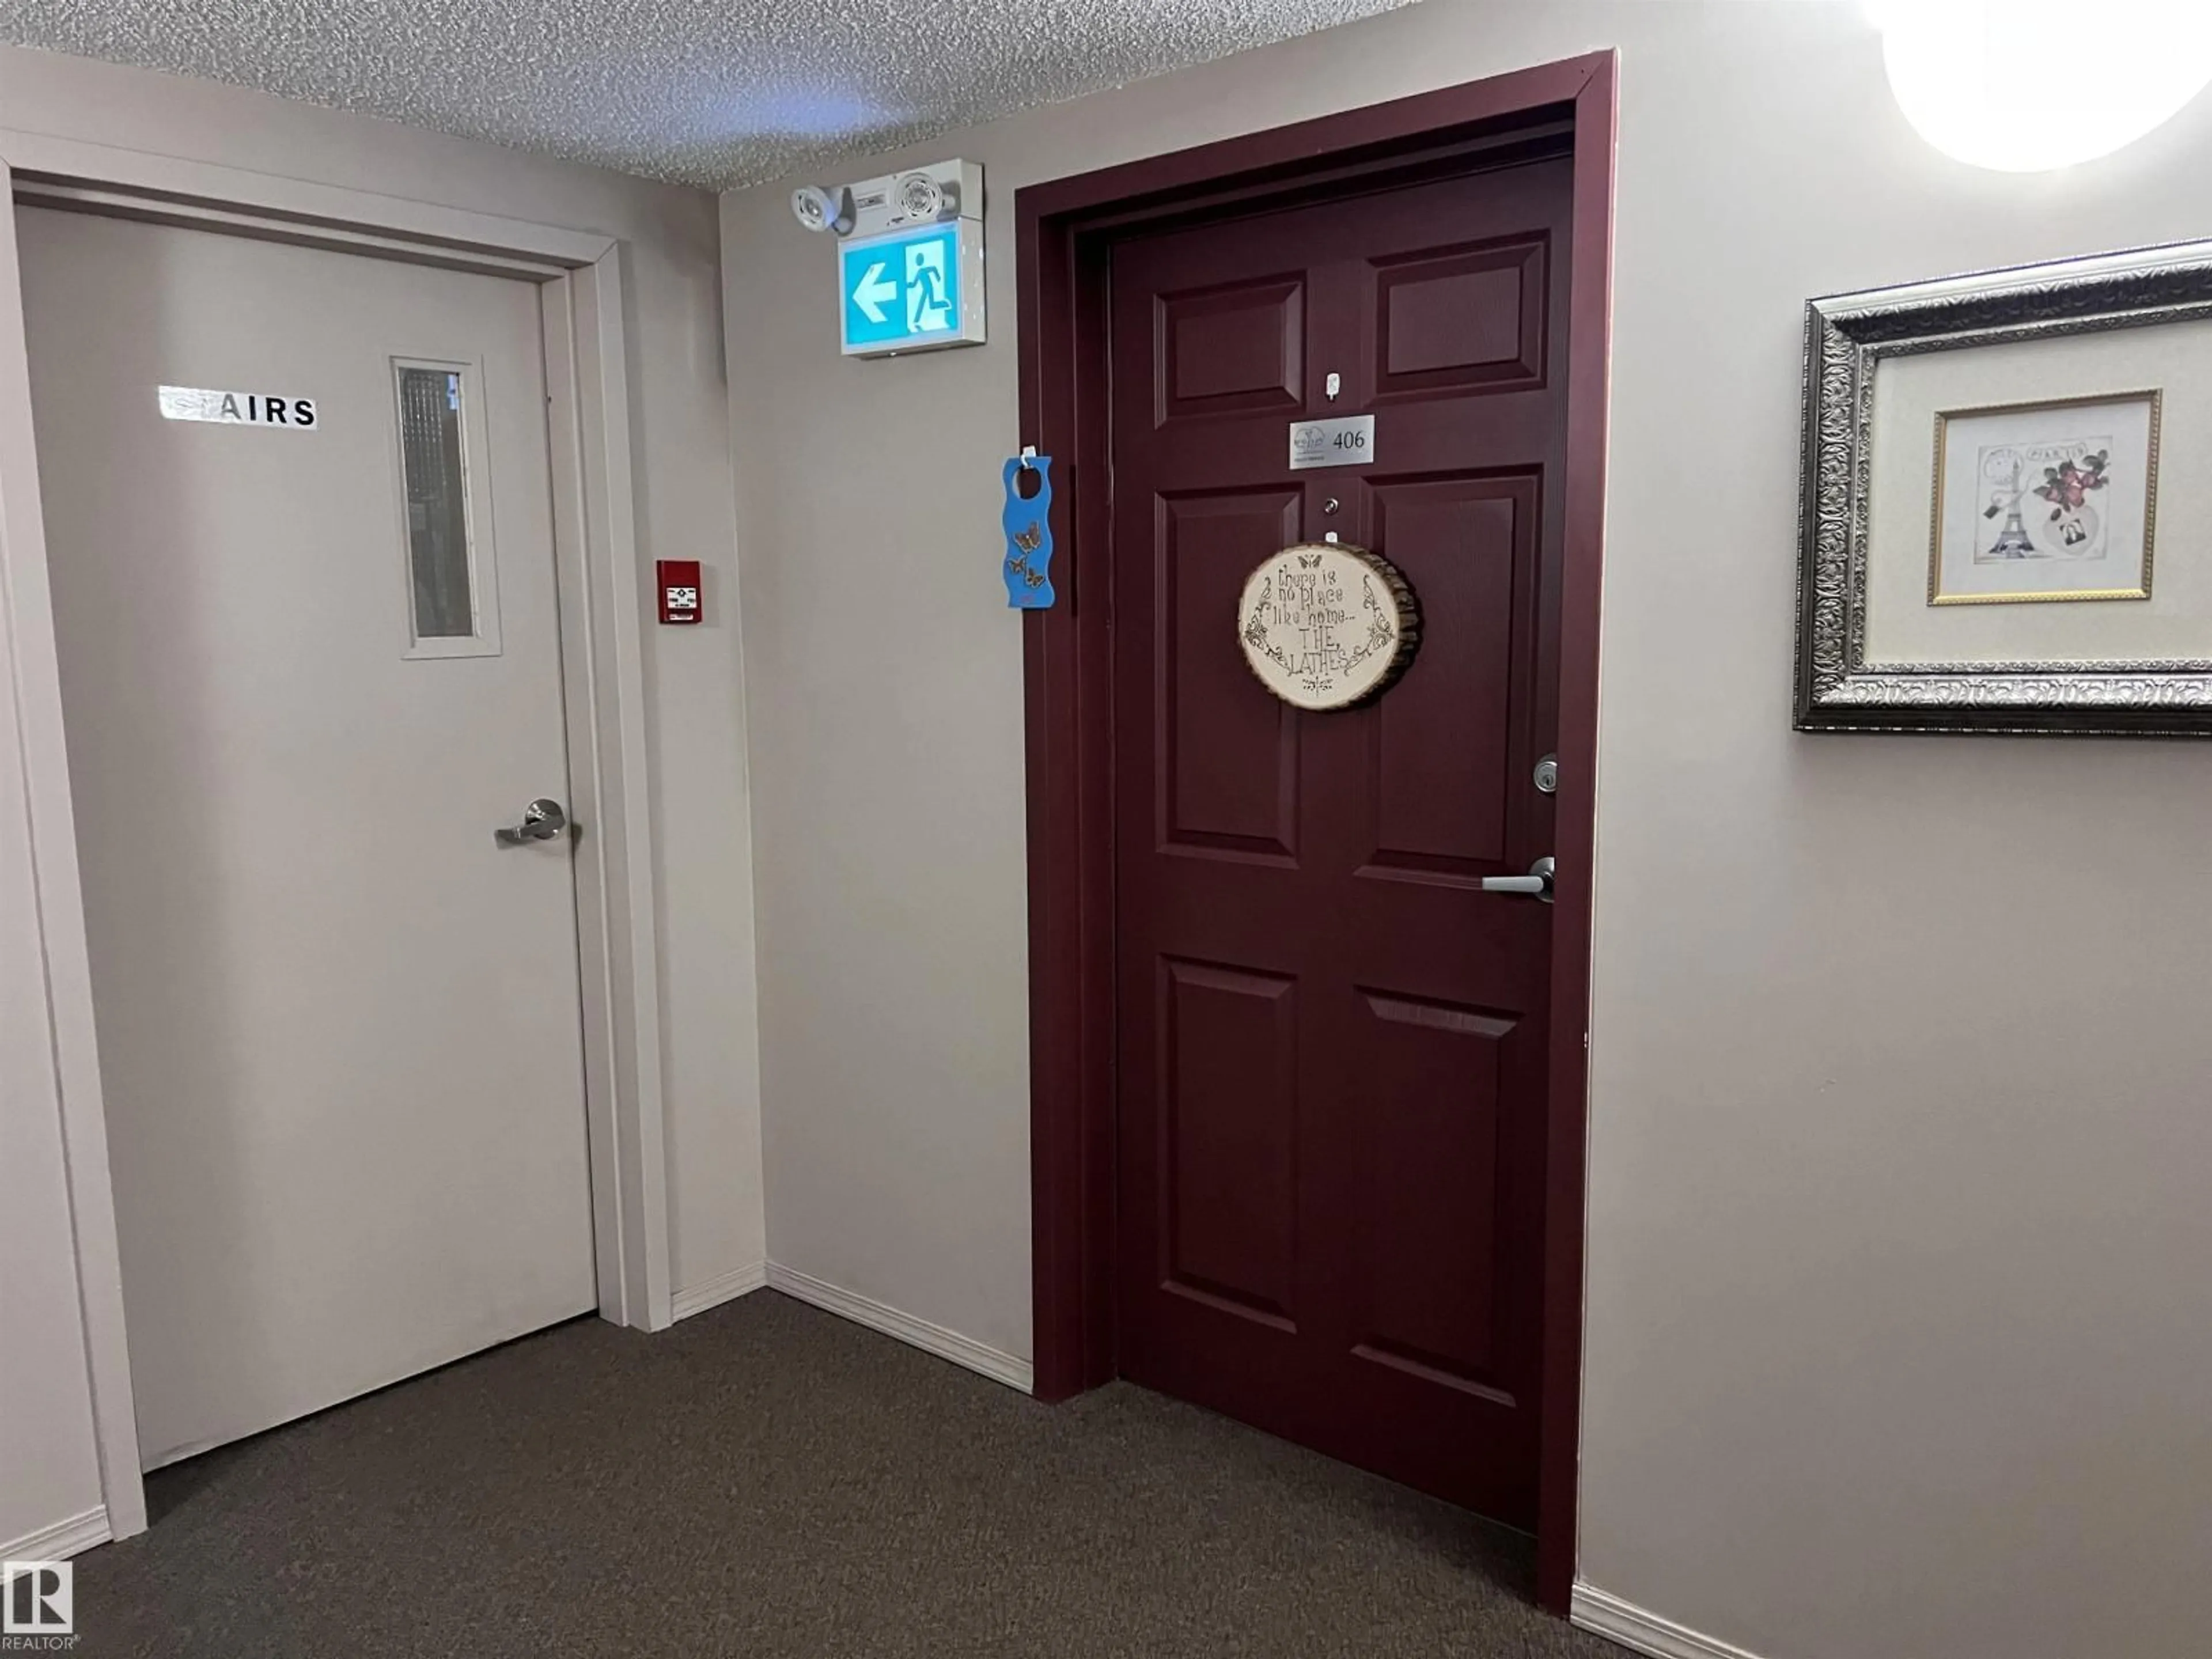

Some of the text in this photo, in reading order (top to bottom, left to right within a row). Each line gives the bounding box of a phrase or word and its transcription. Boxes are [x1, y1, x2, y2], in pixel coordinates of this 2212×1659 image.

[175, 393, 315, 425] AIRS
[1333, 431, 1365, 449] 406
[1279, 565, 1336, 586] there is
[1279, 585, 1343, 610] no place
[1274, 604, 1300, 626] like
